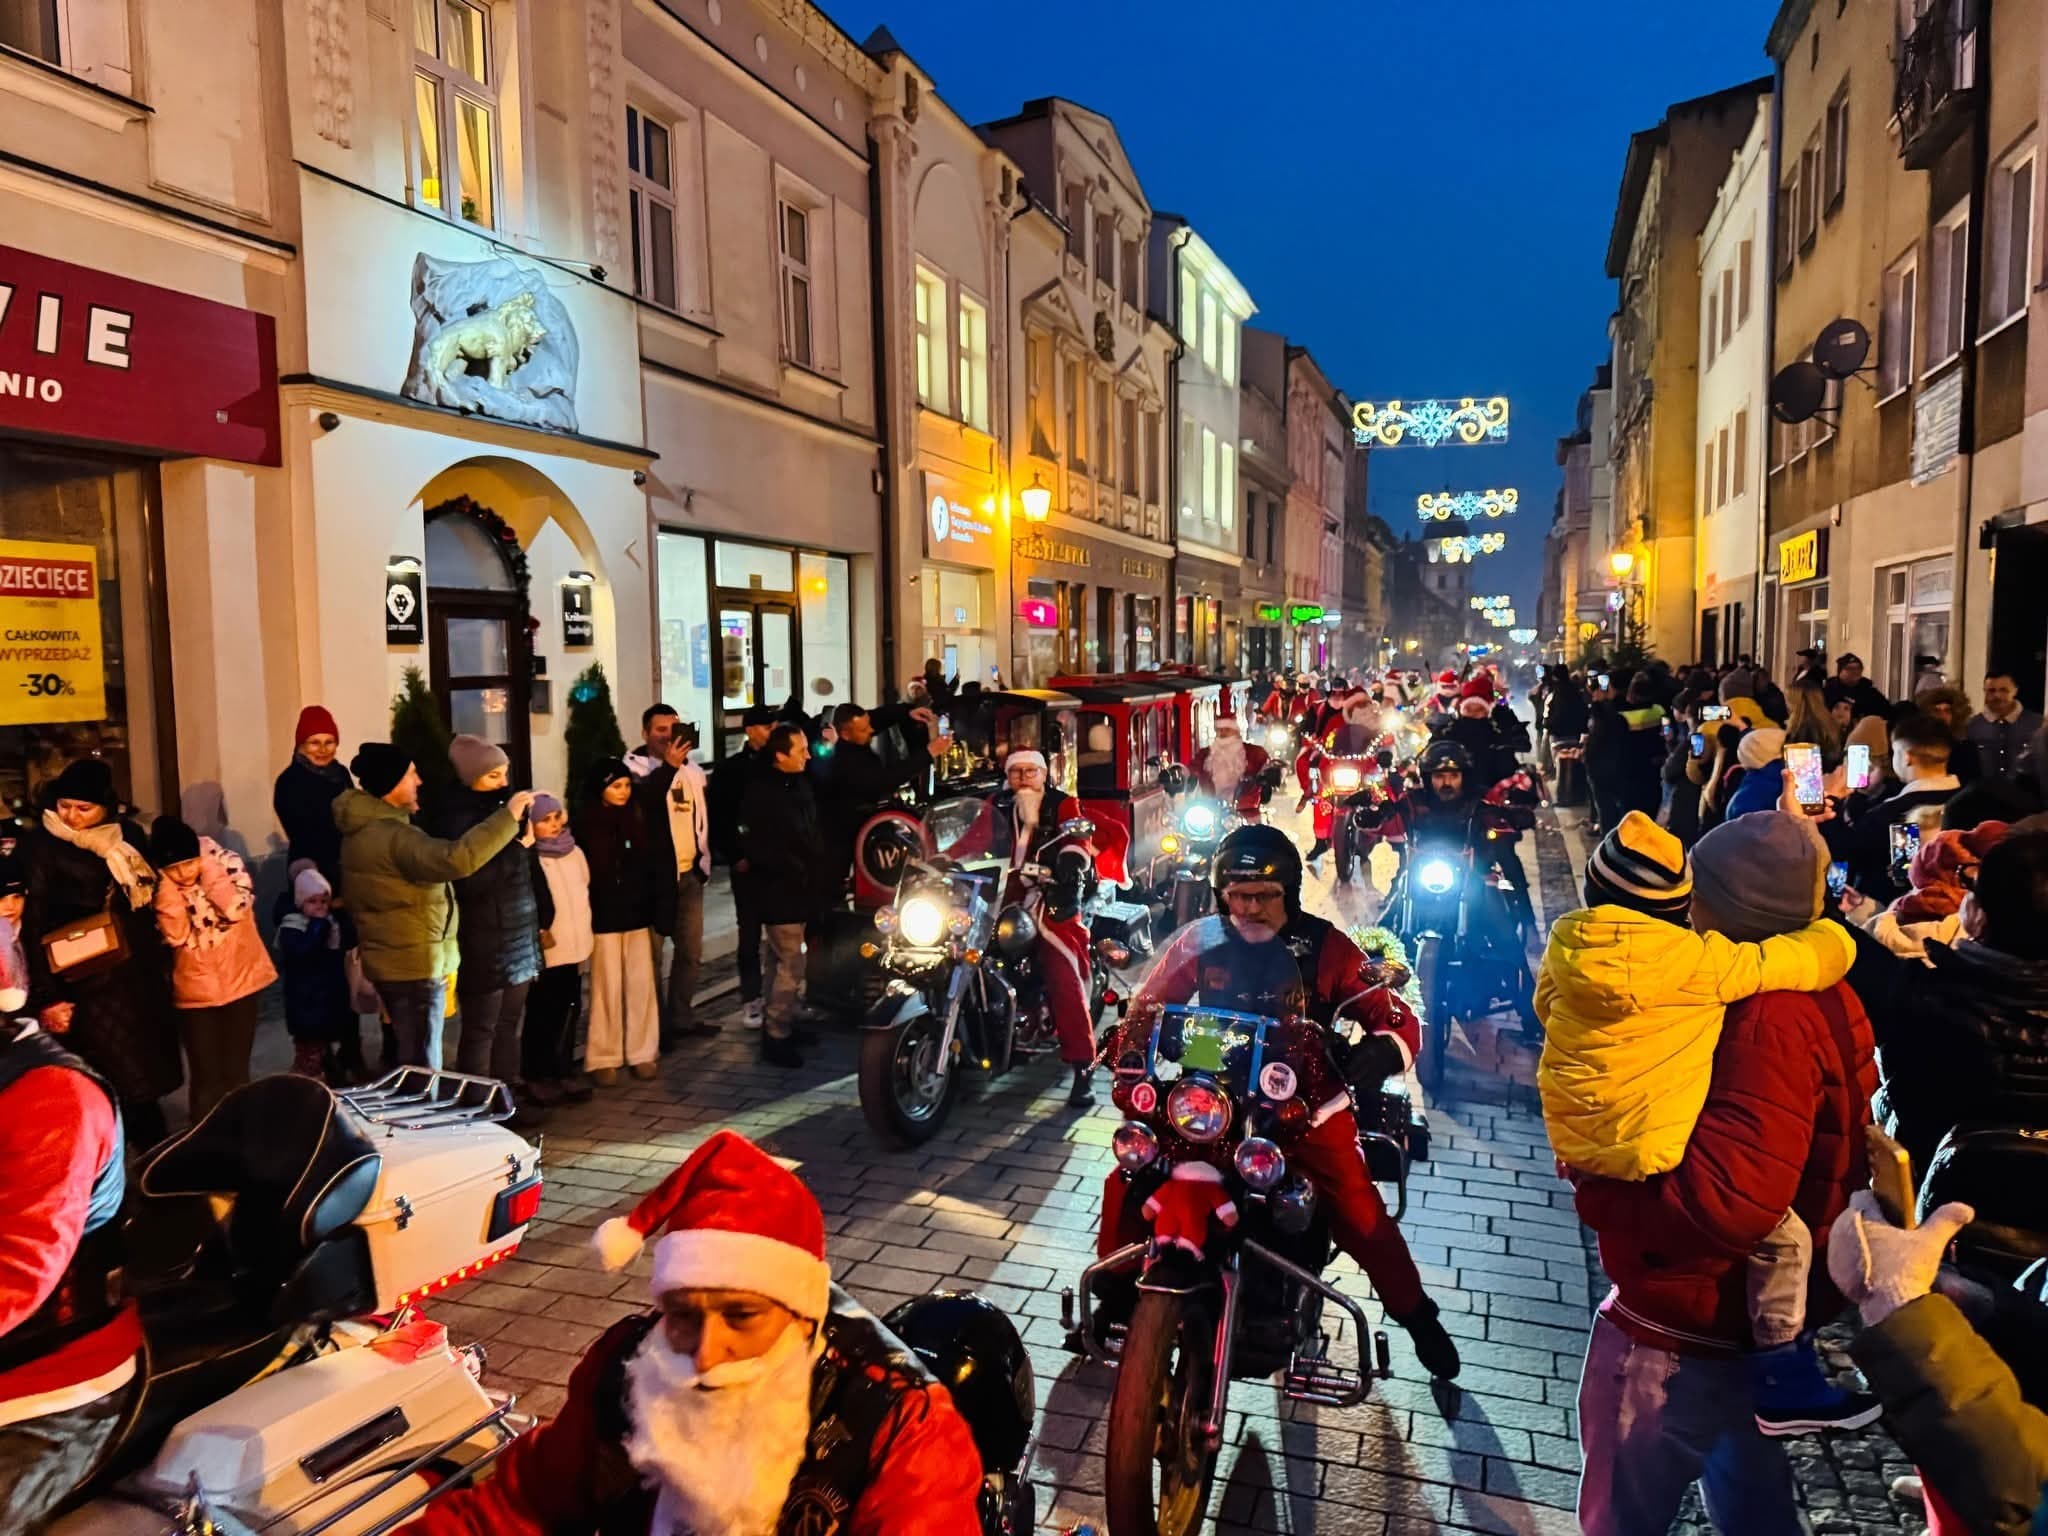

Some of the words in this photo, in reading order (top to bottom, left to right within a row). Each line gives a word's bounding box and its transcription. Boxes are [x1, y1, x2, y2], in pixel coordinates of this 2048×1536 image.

[0, 370, 63, 403] NIO
[5, 629, 81, 642] CAŁKOWITA
[19, 673, 76, 697] -30%
